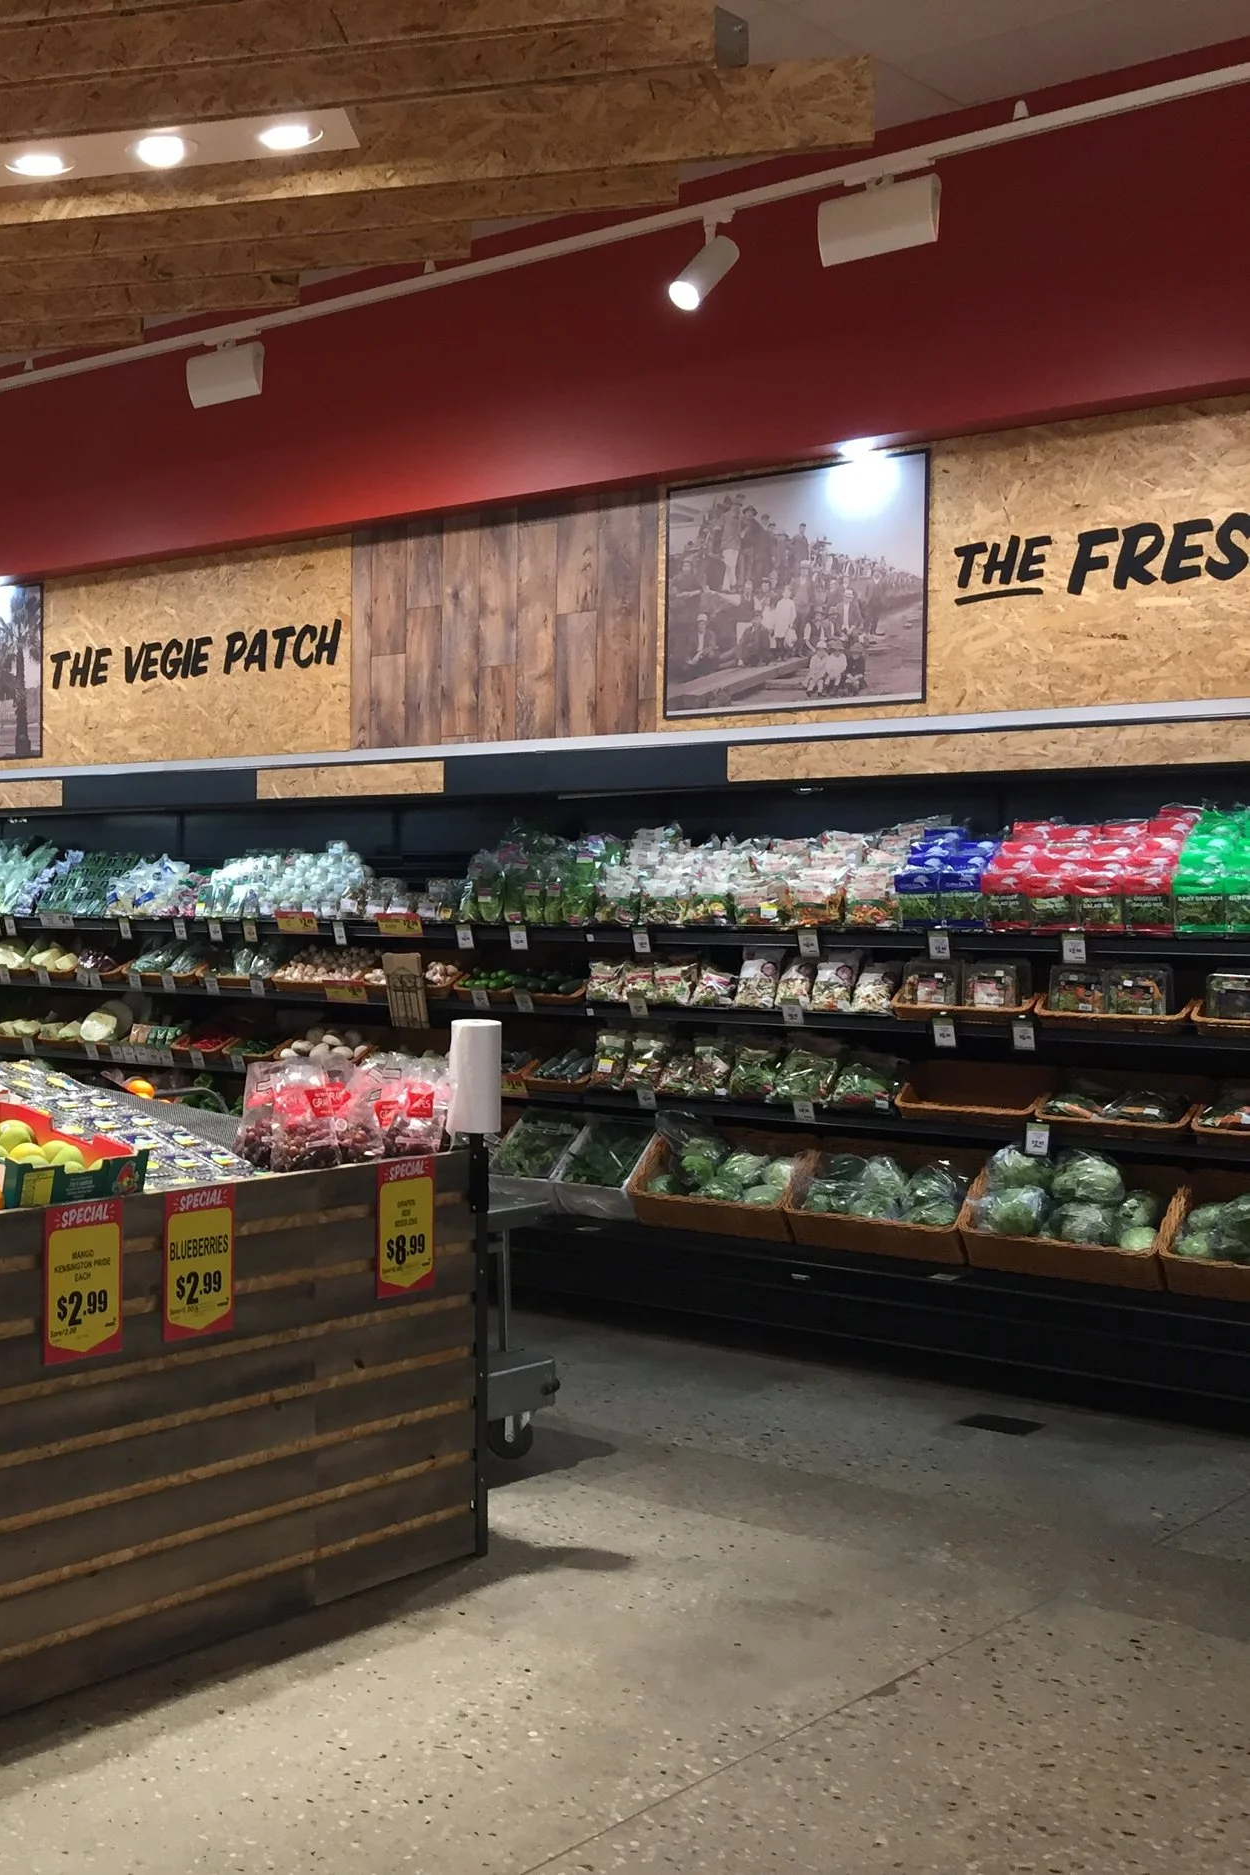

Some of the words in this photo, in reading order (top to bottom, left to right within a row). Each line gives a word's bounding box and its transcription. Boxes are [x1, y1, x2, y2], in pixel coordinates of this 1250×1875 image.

[954, 535, 1052, 588] THE
[1067, 512, 1250, 595] FRES
[50, 646, 112, 689] THE
[124, 636, 213, 684] VEGIE
[223, 618, 342, 675] PATCH
[389, 1160, 425, 1180] SPECIAL
[179, 1189, 223, 1212] SPECIAL
[61, 1203, 110, 1229] SPECIAL
[72, 1249, 94, 1260] MANGO
[170, 1234, 229, 1262] BLUEBERRIES
[386, 1233, 426, 1265] $8.99
[54, 1259, 93, 1274] KENSINGTON
[94, 1256, 111, 1268] PRIDE
[74, 1271, 91, 1283] EACH
[176, 1270, 222, 1305] $2.99
[57, 1289, 108, 1327] $2.99
